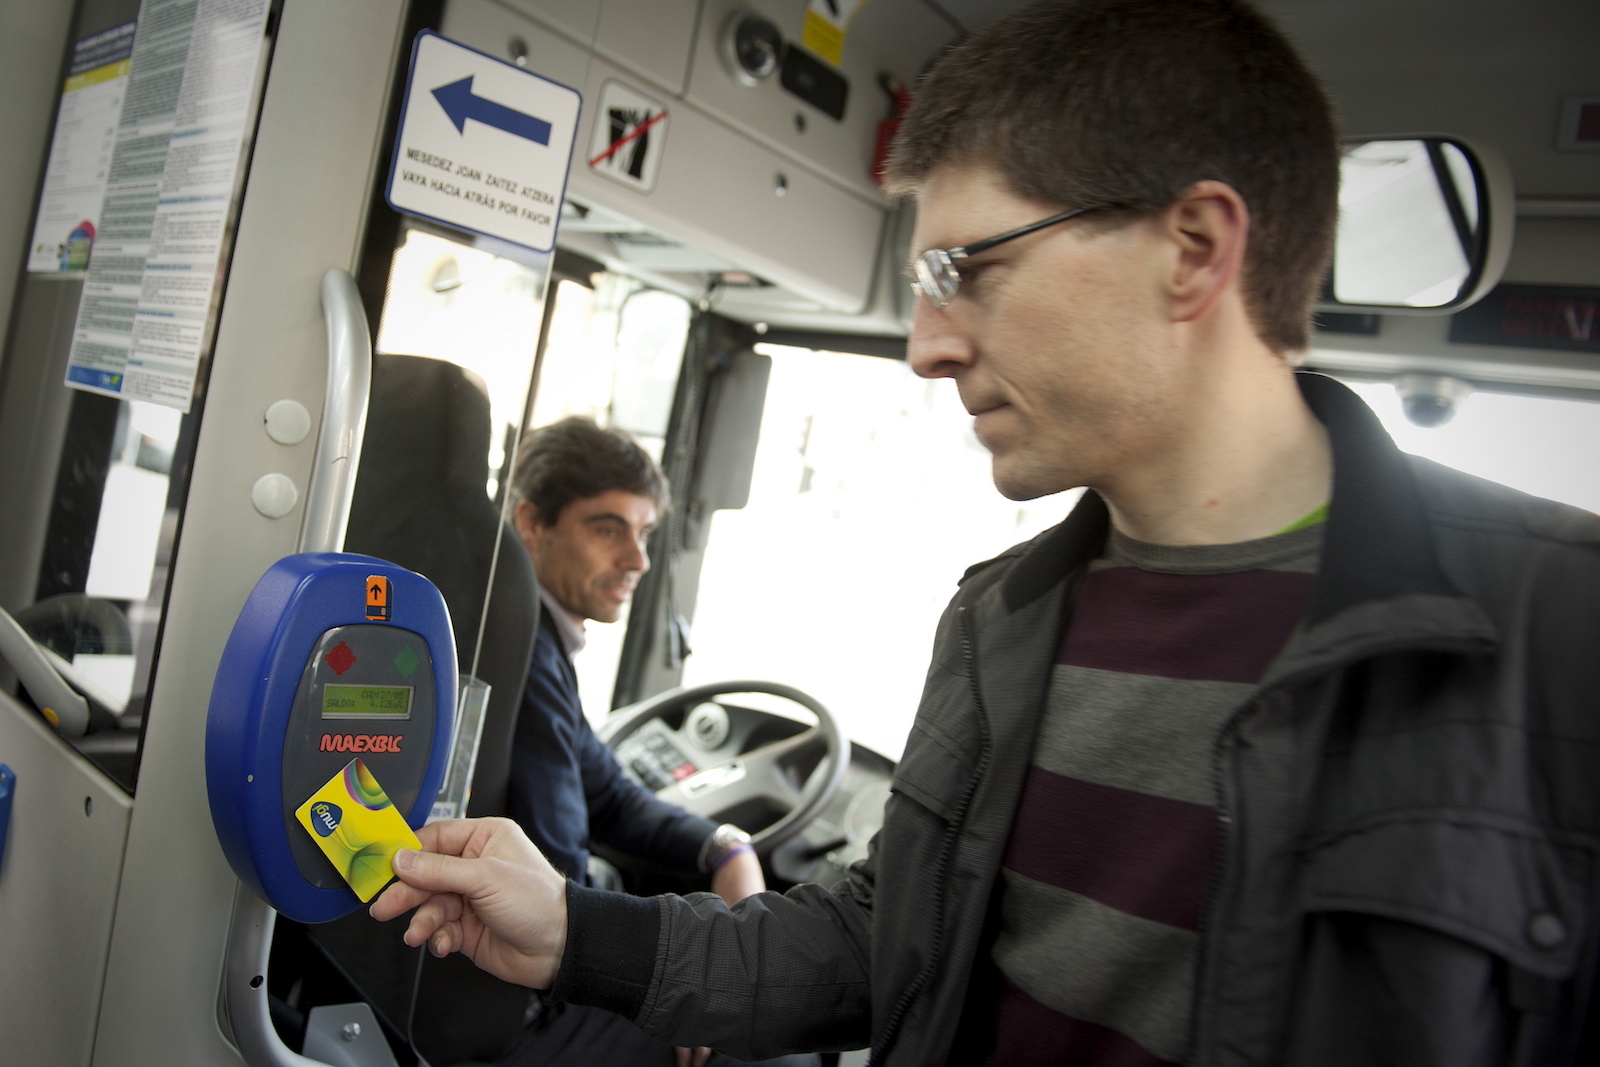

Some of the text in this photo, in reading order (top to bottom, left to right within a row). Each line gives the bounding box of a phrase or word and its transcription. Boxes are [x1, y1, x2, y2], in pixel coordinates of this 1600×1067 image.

[402, 169, 551, 225] VAYA HACIA ATRÁS POR FAVOR
[406, 147, 554, 205] MESEDEZ JOAN ZAITEZ ATZERA
